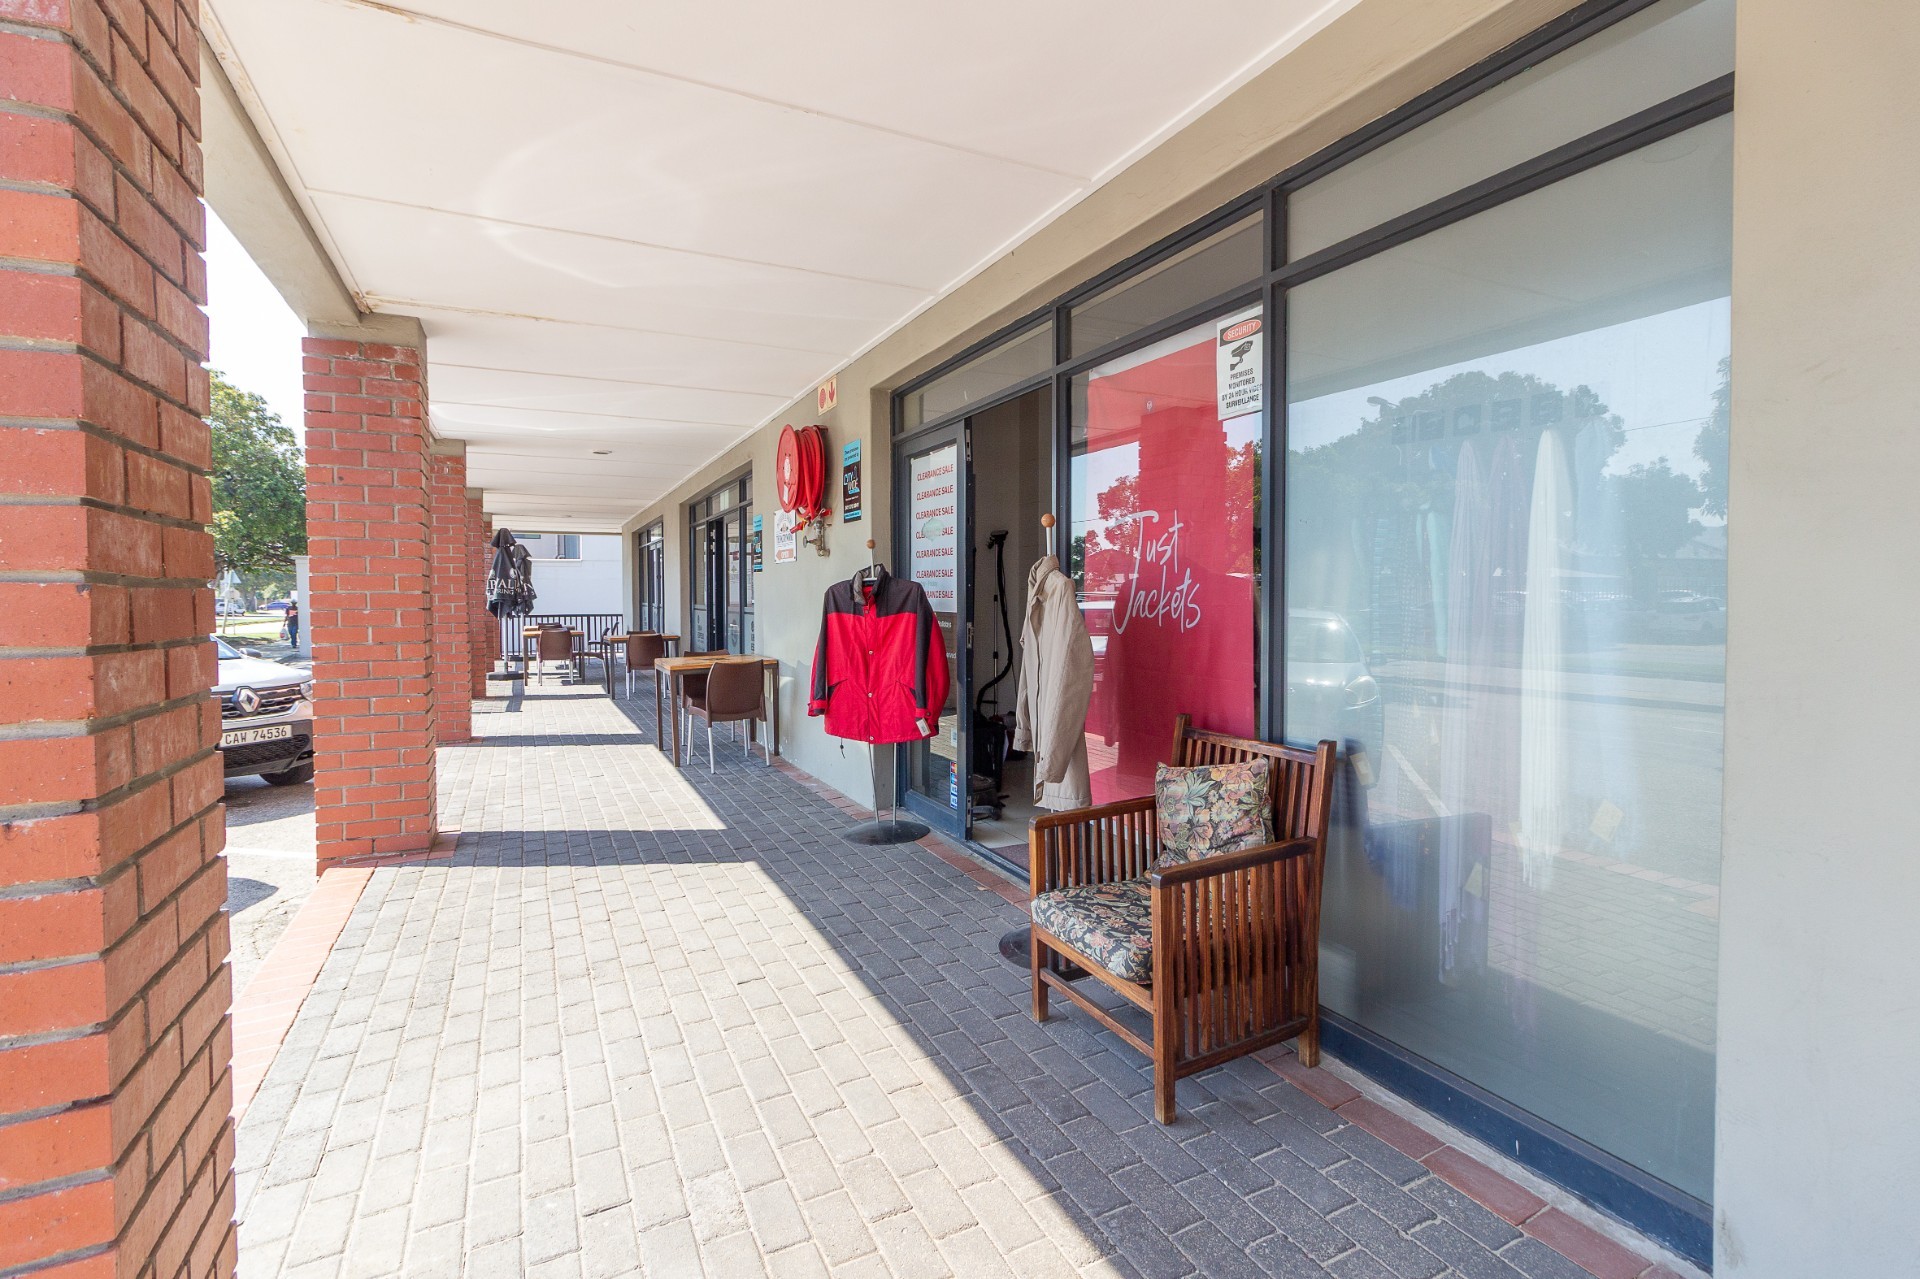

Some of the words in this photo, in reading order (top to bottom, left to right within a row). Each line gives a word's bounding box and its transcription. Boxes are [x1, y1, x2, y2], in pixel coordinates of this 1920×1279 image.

[1227, 321, 1257, 340] SECURITY
[1230, 367, 1254, 381] PREMISES
[1228, 376, 1256, 390] MONITORED
[1225, 393, 1260, 409] SURVEILLANCE
[916, 467, 942, 482] CLEARANCE
[942, 463, 954, 475] SALE
[916, 487, 942, 501] CLEARANCE
[941, 484, 954, 495] SALE
[915, 508, 942, 520] CLEARANCE
[941, 505, 954, 516] SALE
[941, 526, 954, 536] SALE
[1107, 509, 1184, 574] Just
[915, 549, 942, 559] CLEARANCE
[941, 547, 954, 556] SALE
[915, 569, 942, 579] CLEARANCE
[941, 568, 954, 578] SALE
[925, 590, 942, 599] RANCE
[941, 590, 954, 599] SALE
[1111, 565, 1201, 635] Jackets
[225, 732, 248, 745] CAW
[252, 726, 287, 741] 74536
